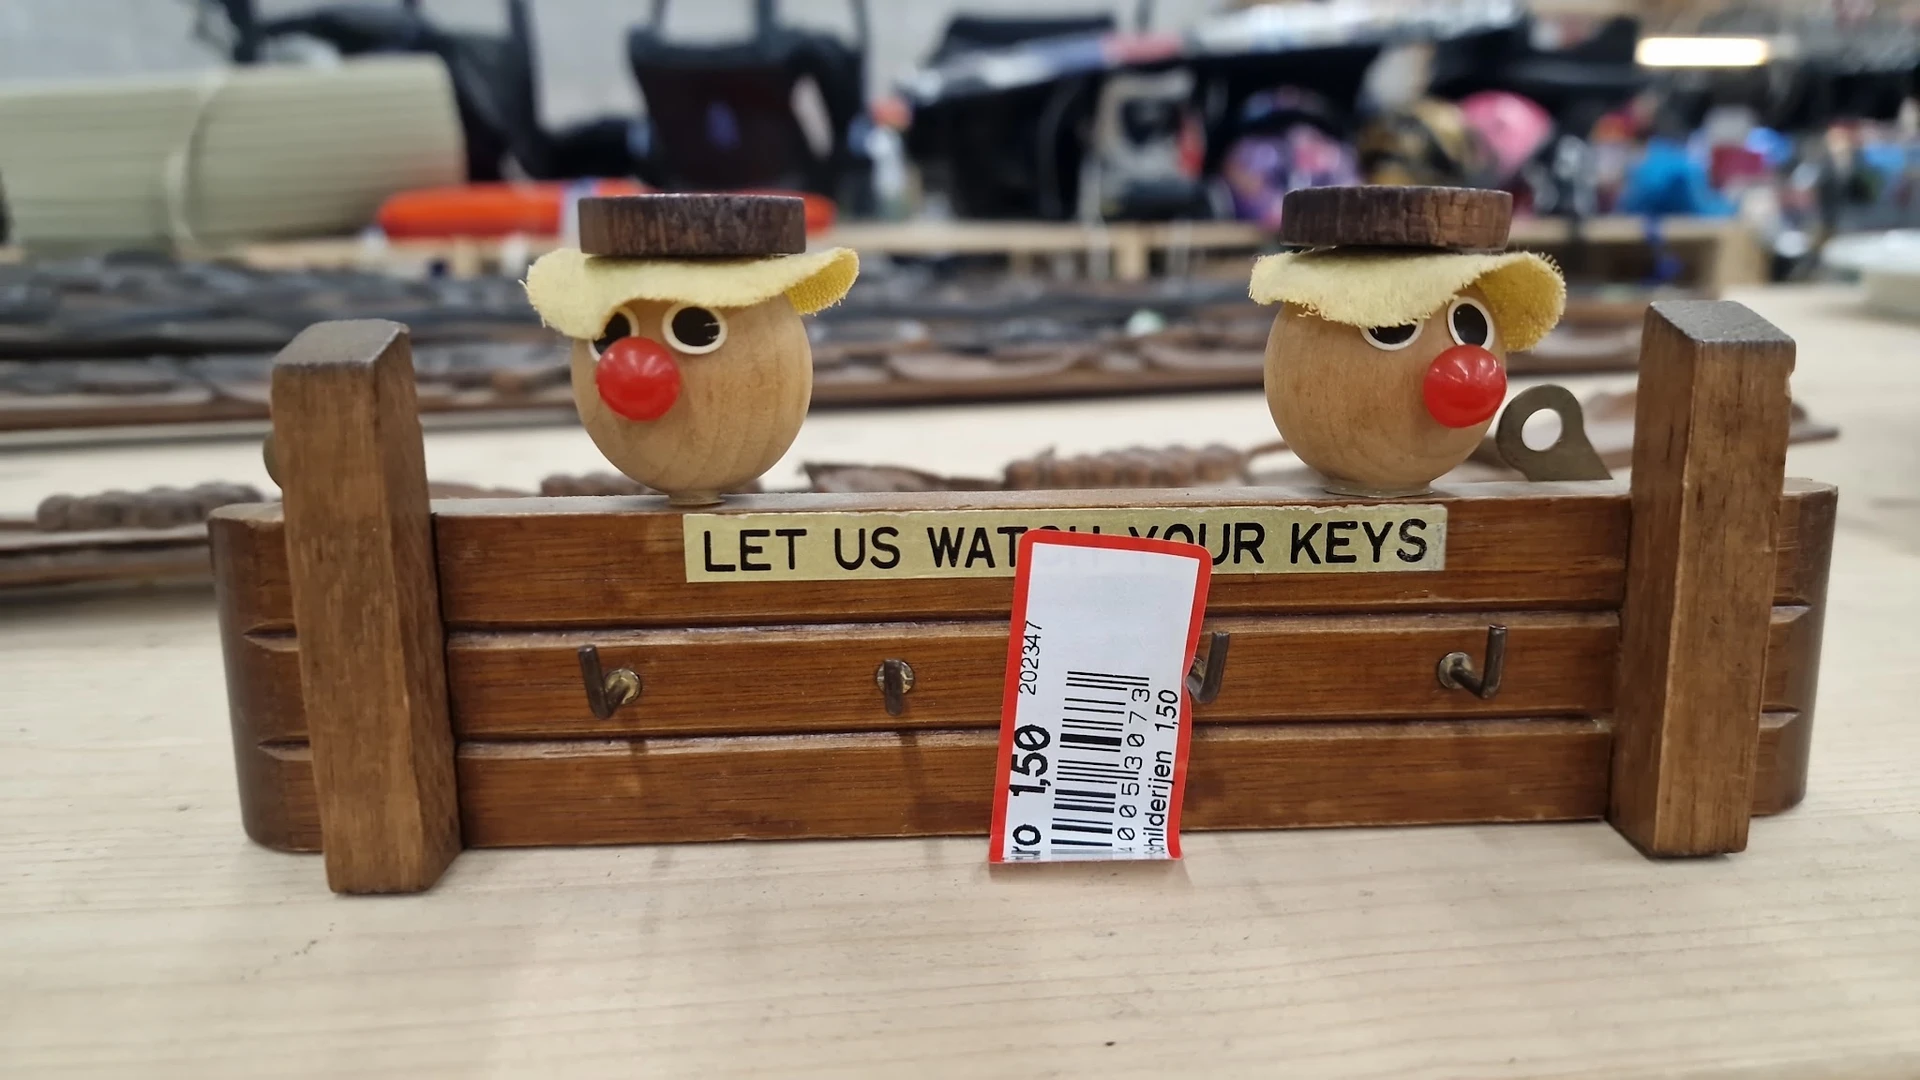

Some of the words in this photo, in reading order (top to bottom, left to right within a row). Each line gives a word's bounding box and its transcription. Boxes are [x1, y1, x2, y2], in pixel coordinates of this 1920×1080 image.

[703, 528, 808, 573] LET
[833, 526, 901, 571] US
[926, 524, 1102, 569] WAT
[1289, 517, 1428, 565] KEYS
[1018, 619, 1043, 696] 202347
[1154, 689, 1180, 732] 1,50
[1009, 723, 1052, 797] 1,50
